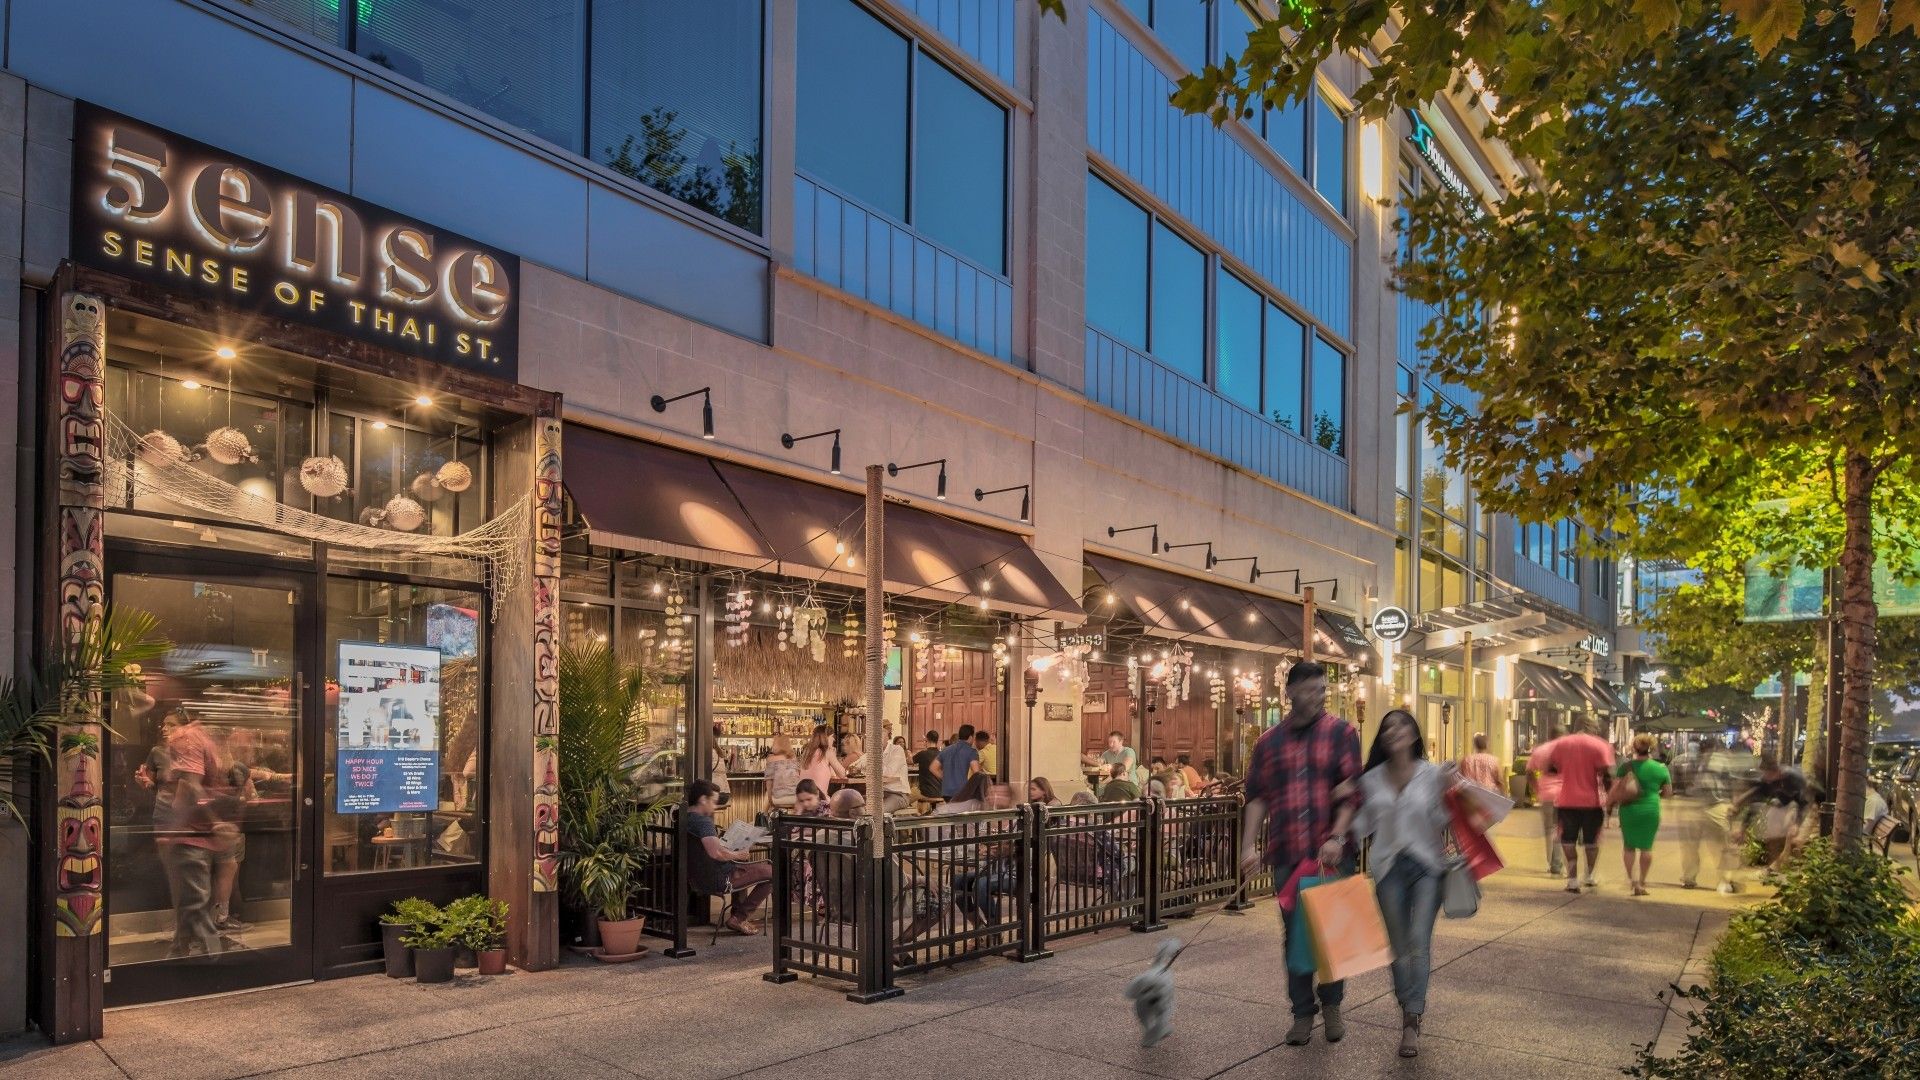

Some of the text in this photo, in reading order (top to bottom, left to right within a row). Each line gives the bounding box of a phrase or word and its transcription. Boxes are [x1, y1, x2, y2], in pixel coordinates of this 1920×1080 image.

[103, 230, 500, 364] SENSE OF THAI ST.
